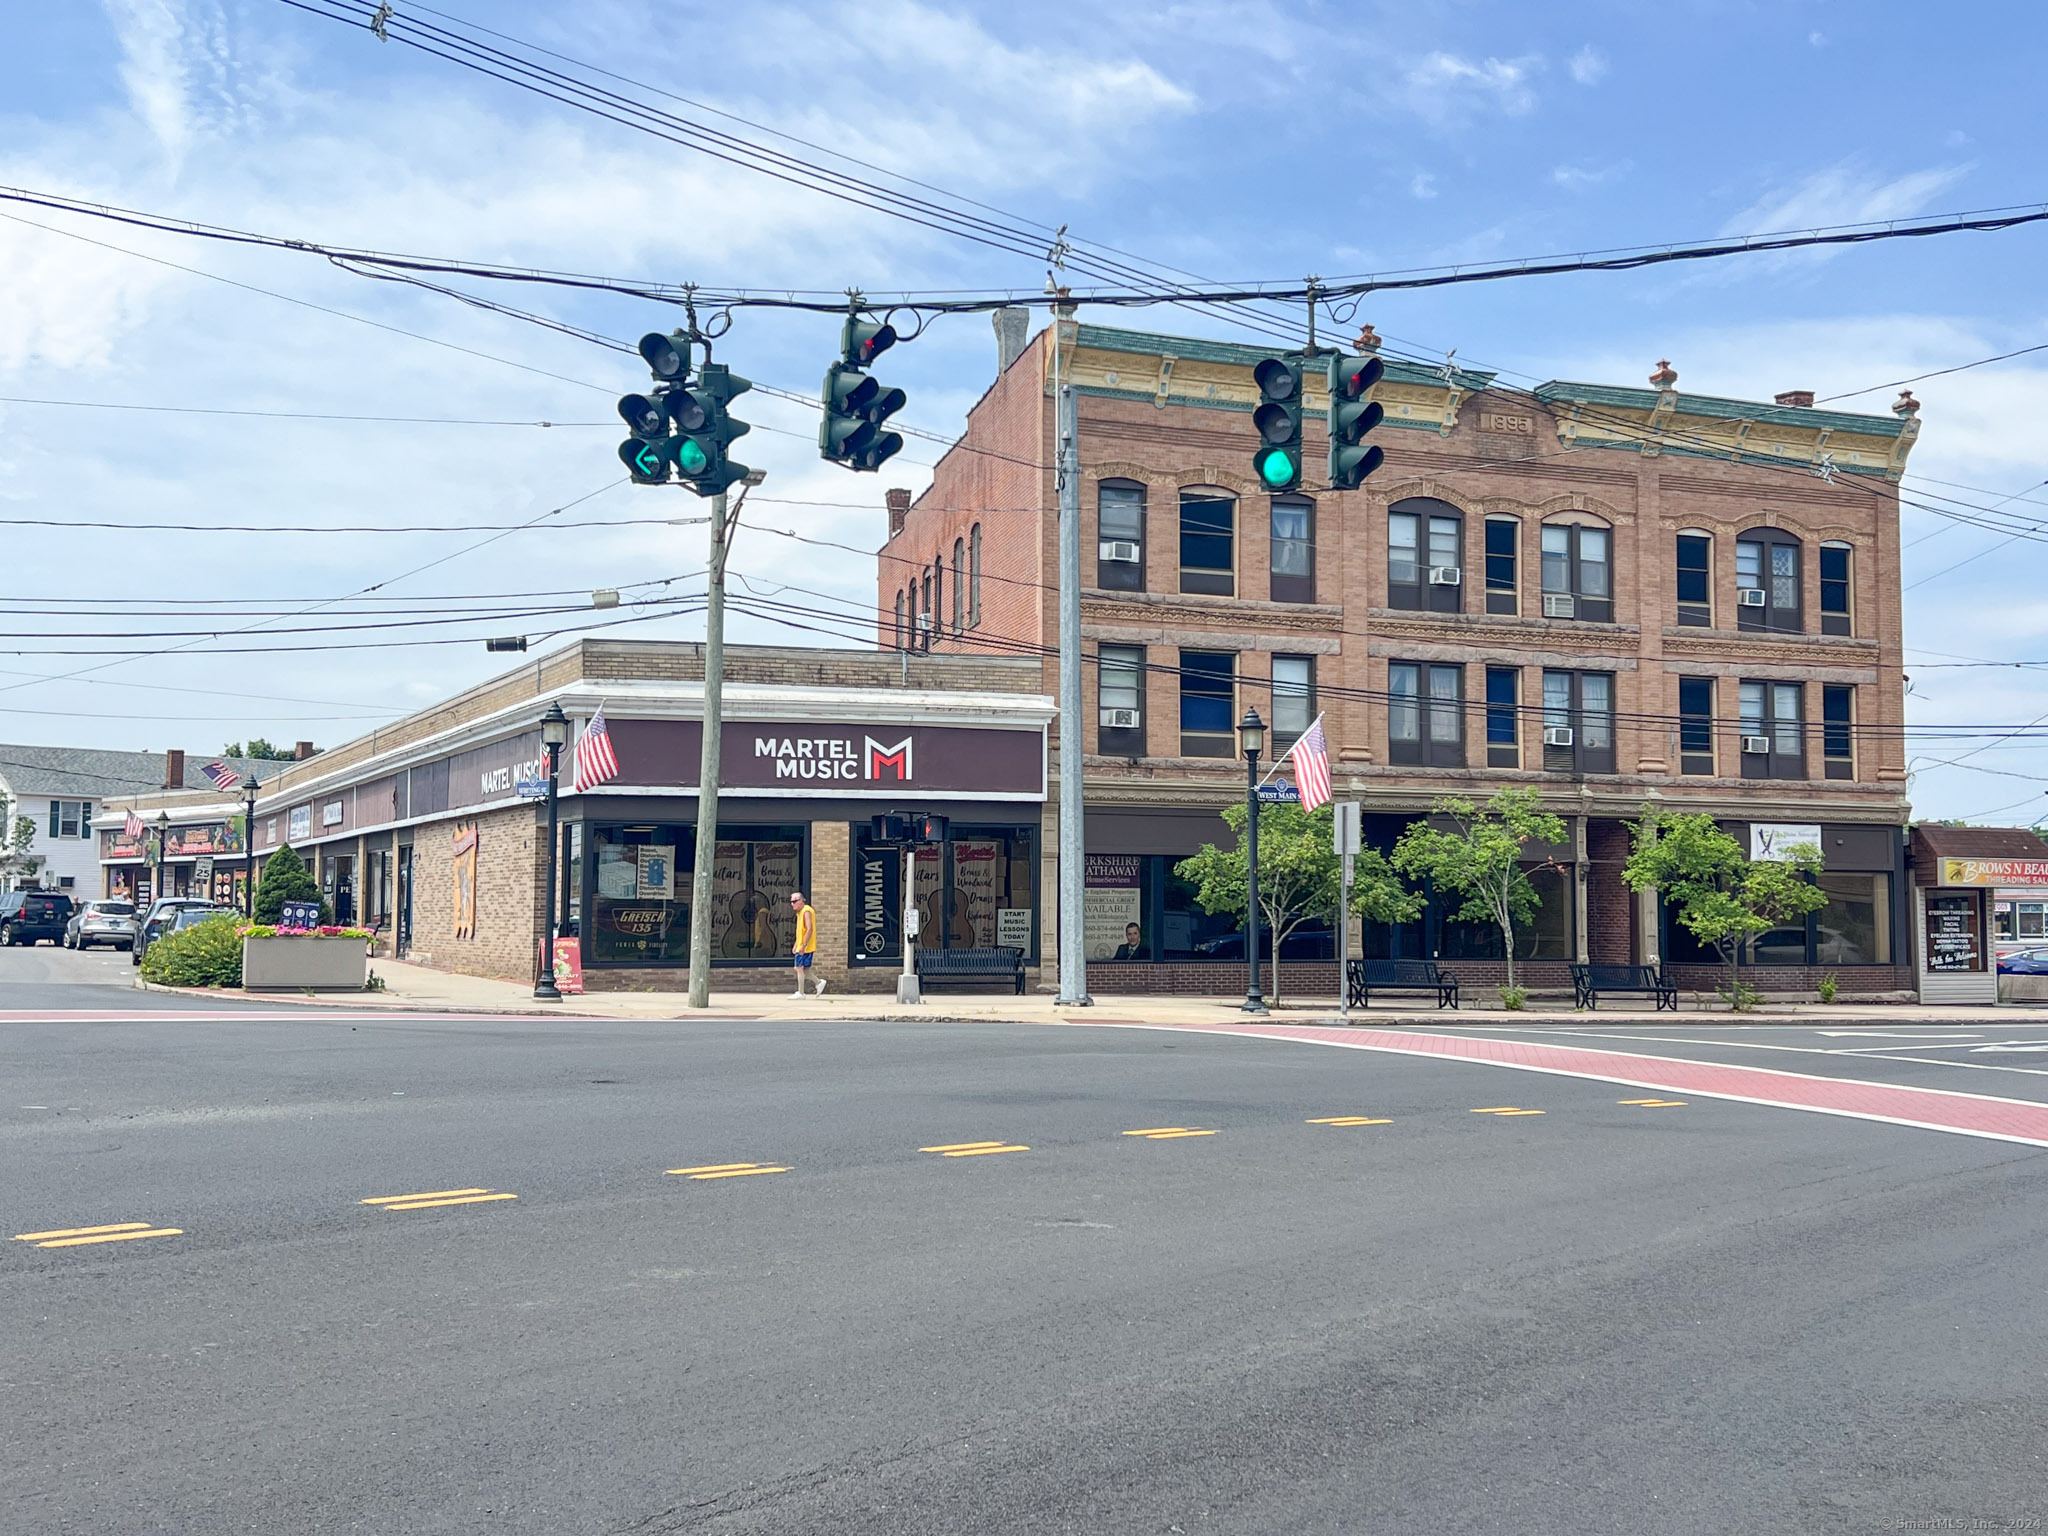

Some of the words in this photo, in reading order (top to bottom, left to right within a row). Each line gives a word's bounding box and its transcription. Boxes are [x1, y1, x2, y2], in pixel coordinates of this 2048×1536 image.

[755, 738, 858, 759] MARTEL
[776, 759, 858, 779] MUSIC
[481, 767, 511, 795] MARTEL
[196, 869, 210, 877] 25
[1086, 866, 1138, 876] ATHAWAY
[1086, 876, 1130, 884] HomeServices
[1961, 862, 2011, 882] BROWS
[2013, 864, 2022, 874] N
[865, 860, 883, 931] YAMAHA
[632, 923, 652, 932] 135
